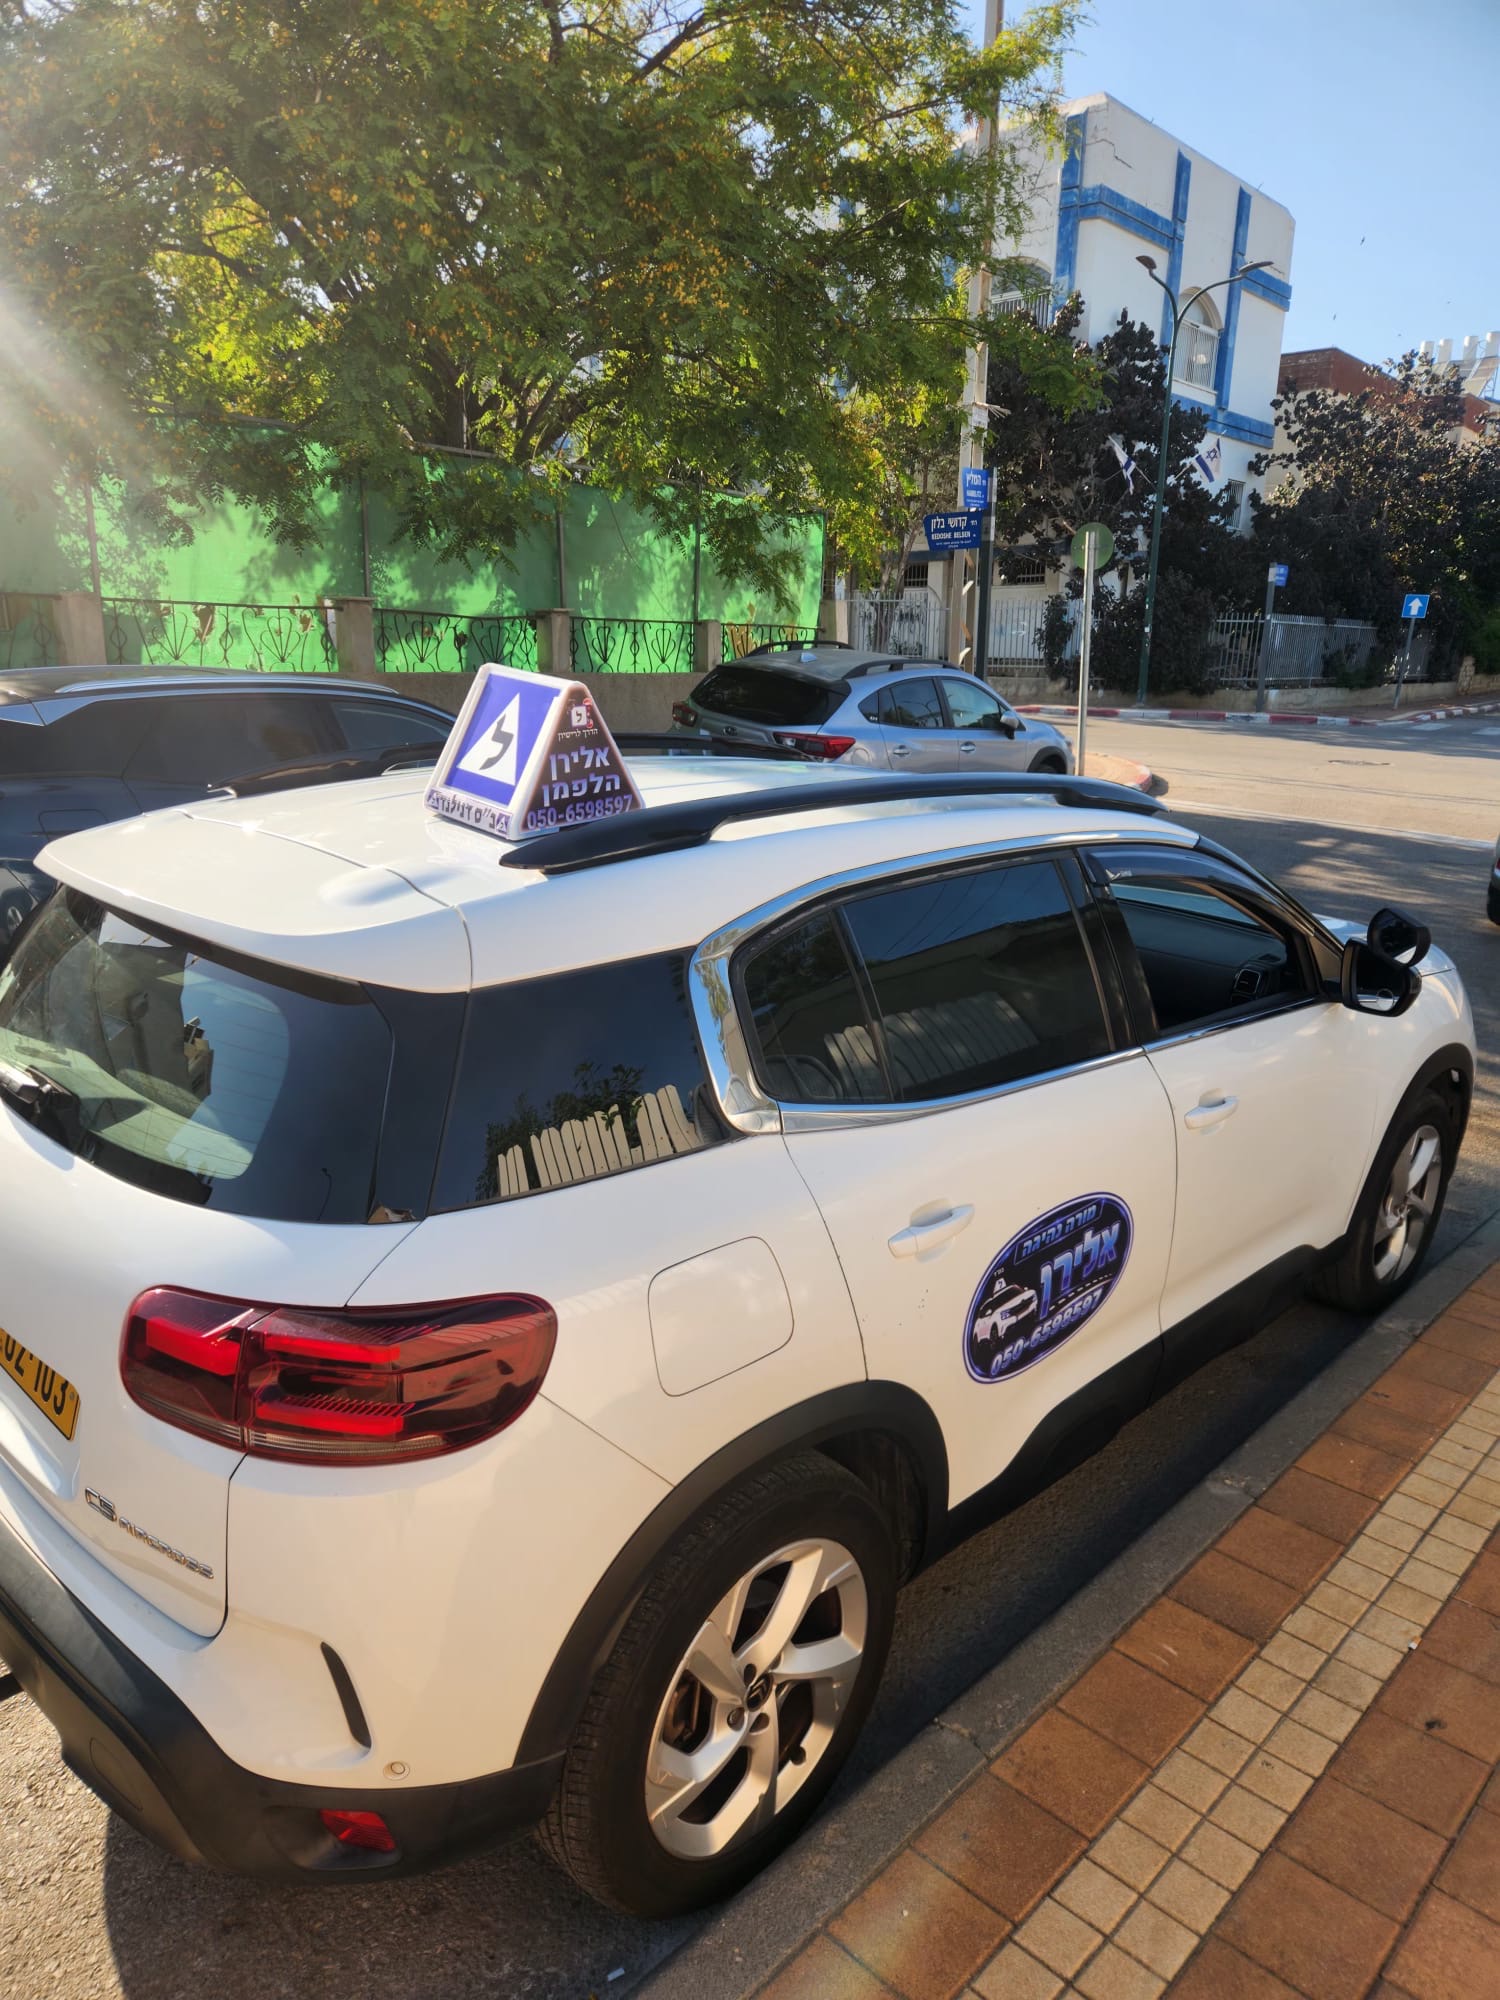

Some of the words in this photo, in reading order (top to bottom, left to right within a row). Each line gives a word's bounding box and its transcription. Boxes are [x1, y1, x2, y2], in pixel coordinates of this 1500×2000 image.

[931, 515, 945, 532] בלזן
[947, 516, 968, 530] קדושי
[953, 530, 971, 539] BELSEN
[582, 728, 598, 739] הדרך
[549, 746, 610, 781] אלירן
[542, 772, 621, 807] הלפמן
[526, 794, 634, 831] 050-6598597
[1064, 1203, 1097, 1232] מורה
[1022, 1224, 1064, 1257] נהיגה
[1039, 1221, 1121, 1320] אלירן
[990, 1287, 1104, 1378] 050-6598597
[84, 1486, 117, 1522] C5
[118, 1515, 215, 1580] AIRCROSS
